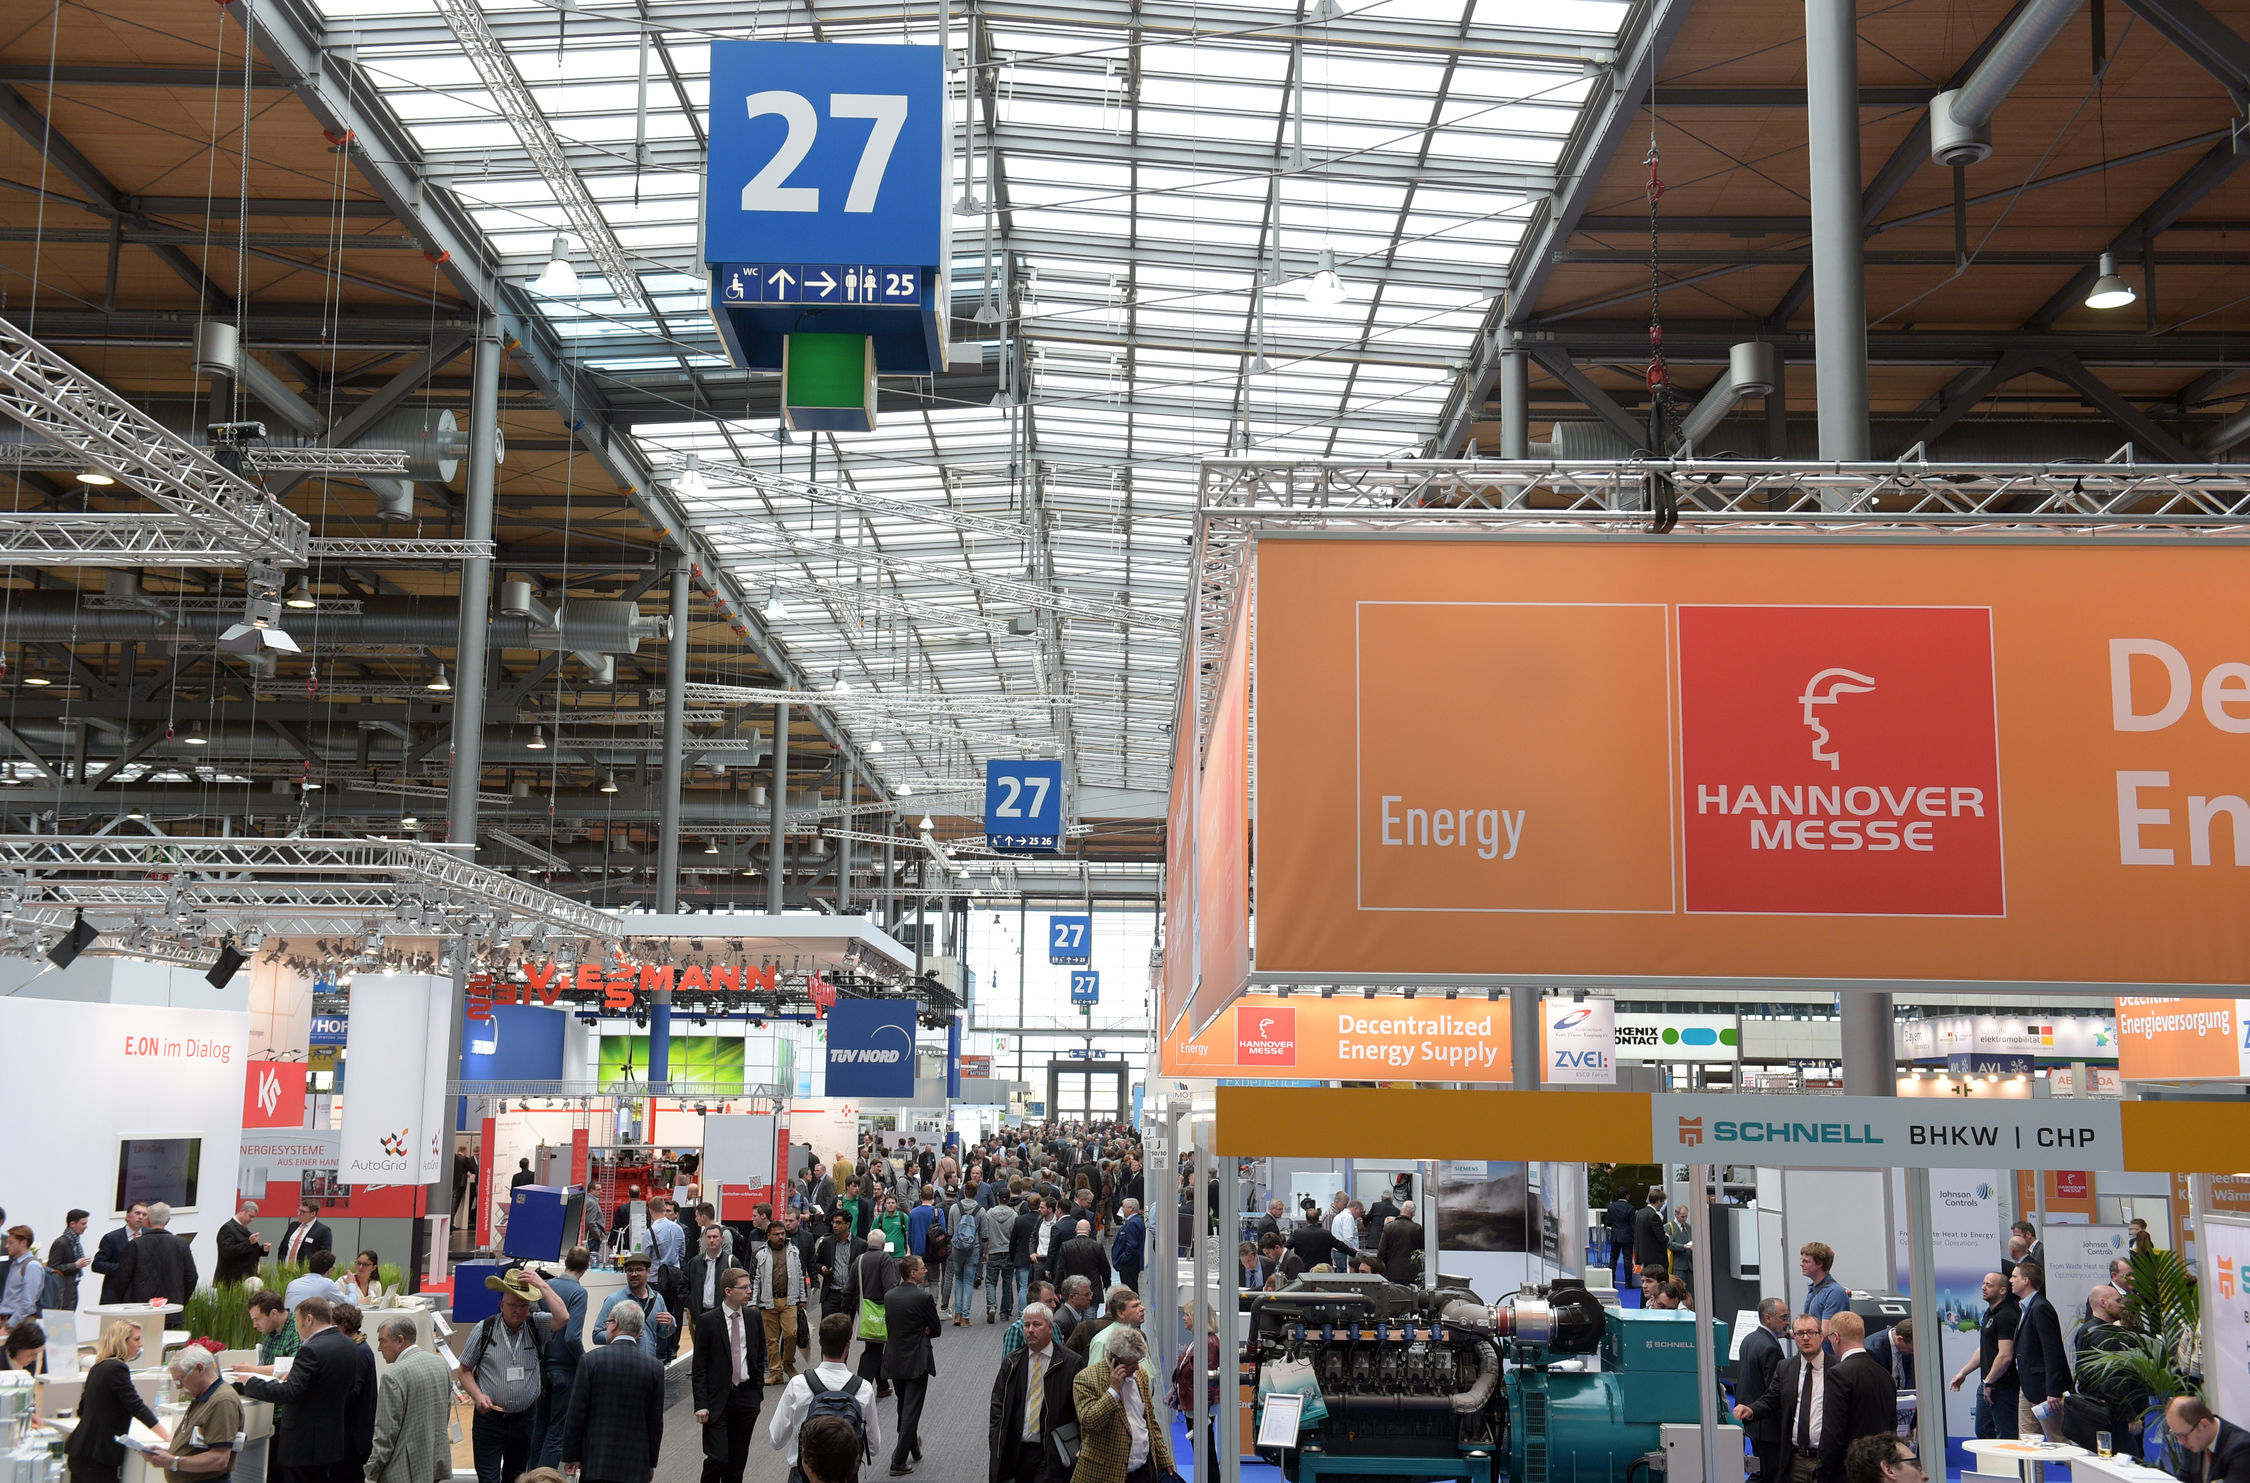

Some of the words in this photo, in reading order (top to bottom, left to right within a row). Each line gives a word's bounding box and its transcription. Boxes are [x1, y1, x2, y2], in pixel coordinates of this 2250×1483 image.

[741, 90, 908, 213] 27
[743, 268, 758, 276] WC
[886, 274, 914, 296] 25
[2109, 638, 2250, 734] De
[995, 776, 1050, 818] 27
[1697, 784, 1985, 817] HANNOVER
[1381, 795, 1526, 860] Energy
[2116, 770, 2250, 866] En
[1029, 836, 1039, 846] 25
[1041, 836, 1052, 846] 26
[1750, 819, 1934, 851] MESSE
[1054, 924, 1085, 947] 27
[1074, 976, 1096, 993] 27
[1338, 1014, 1492, 1036] Decentralized
[2120, 1010, 2230, 1039] Energieversorgung
[125, 1036, 159, 1056] E.ON
[163, 1038, 181, 1057] im
[186, 1039, 231, 1064] Dialog
[1181, 1043, 1208, 1056] Energy
[1239, 1040, 1294, 1049] HANNOVER
[1248, 1047, 1284, 1055] MESSE
[1338, 1040, 1416, 1066] Energy
[1421, 1041, 1497, 1067] Supply
[830, 1049, 858, 1063] TÜV
[857, 1049, 900, 1063] NORD
[1950, 1062, 1961, 1073] AVL
[1978, 1062, 2005, 1073] AVL
[1157, 1139, 1161, 1149] J
[1713, 1121, 1884, 1144] SCHNELL
[1910, 1125, 1999, 1146] BHKW
[2036, 1127, 2096, 1148] CHP
[277, 1158, 293, 1166] AUS
[295, 1158, 317, 1166] EINER
[351, 1159, 407, 1171] AutoGrid
[1940, 1190, 1971, 1198] Johnson
[2087, 1248, 2113, 1256] Controls
